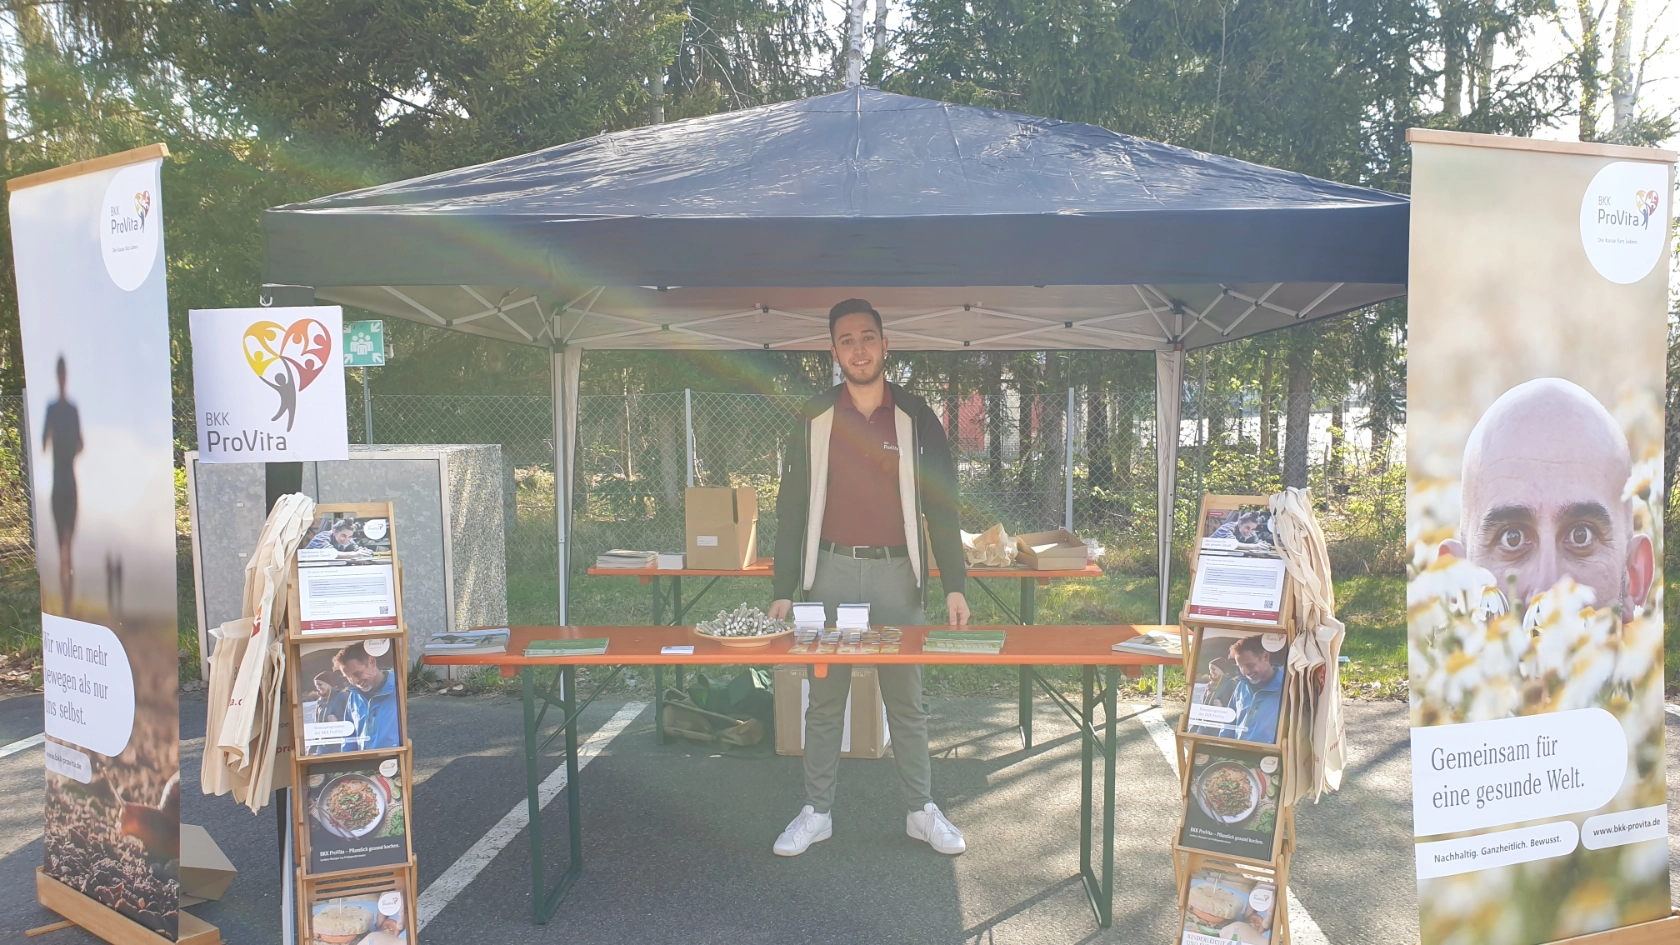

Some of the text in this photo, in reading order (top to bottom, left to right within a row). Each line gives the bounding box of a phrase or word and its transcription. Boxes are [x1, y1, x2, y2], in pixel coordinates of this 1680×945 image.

[1598, 195, 1611, 206] BKK
[112, 217, 138, 234] ProVita
[1598, 209, 1639, 226] ProVita
[206, 412, 230, 426] BKK
[207, 430, 287, 452] ProVita
[56, 637, 84, 661] wollen
[86, 645, 108, 667] mehr
[79, 673, 91, 696] als
[94, 684, 108, 700] nur
[59, 701, 87, 725] selbst.
[1431, 735, 1558, 771] Gemeinsam für
[1432, 766, 1585, 810] eine gesunde Welt.
[1593, 817, 1661, 837] www.bkk-provita.de
[1434, 835, 1562, 864] Nachhaltig. Ganzheitlich. Bewusst.
